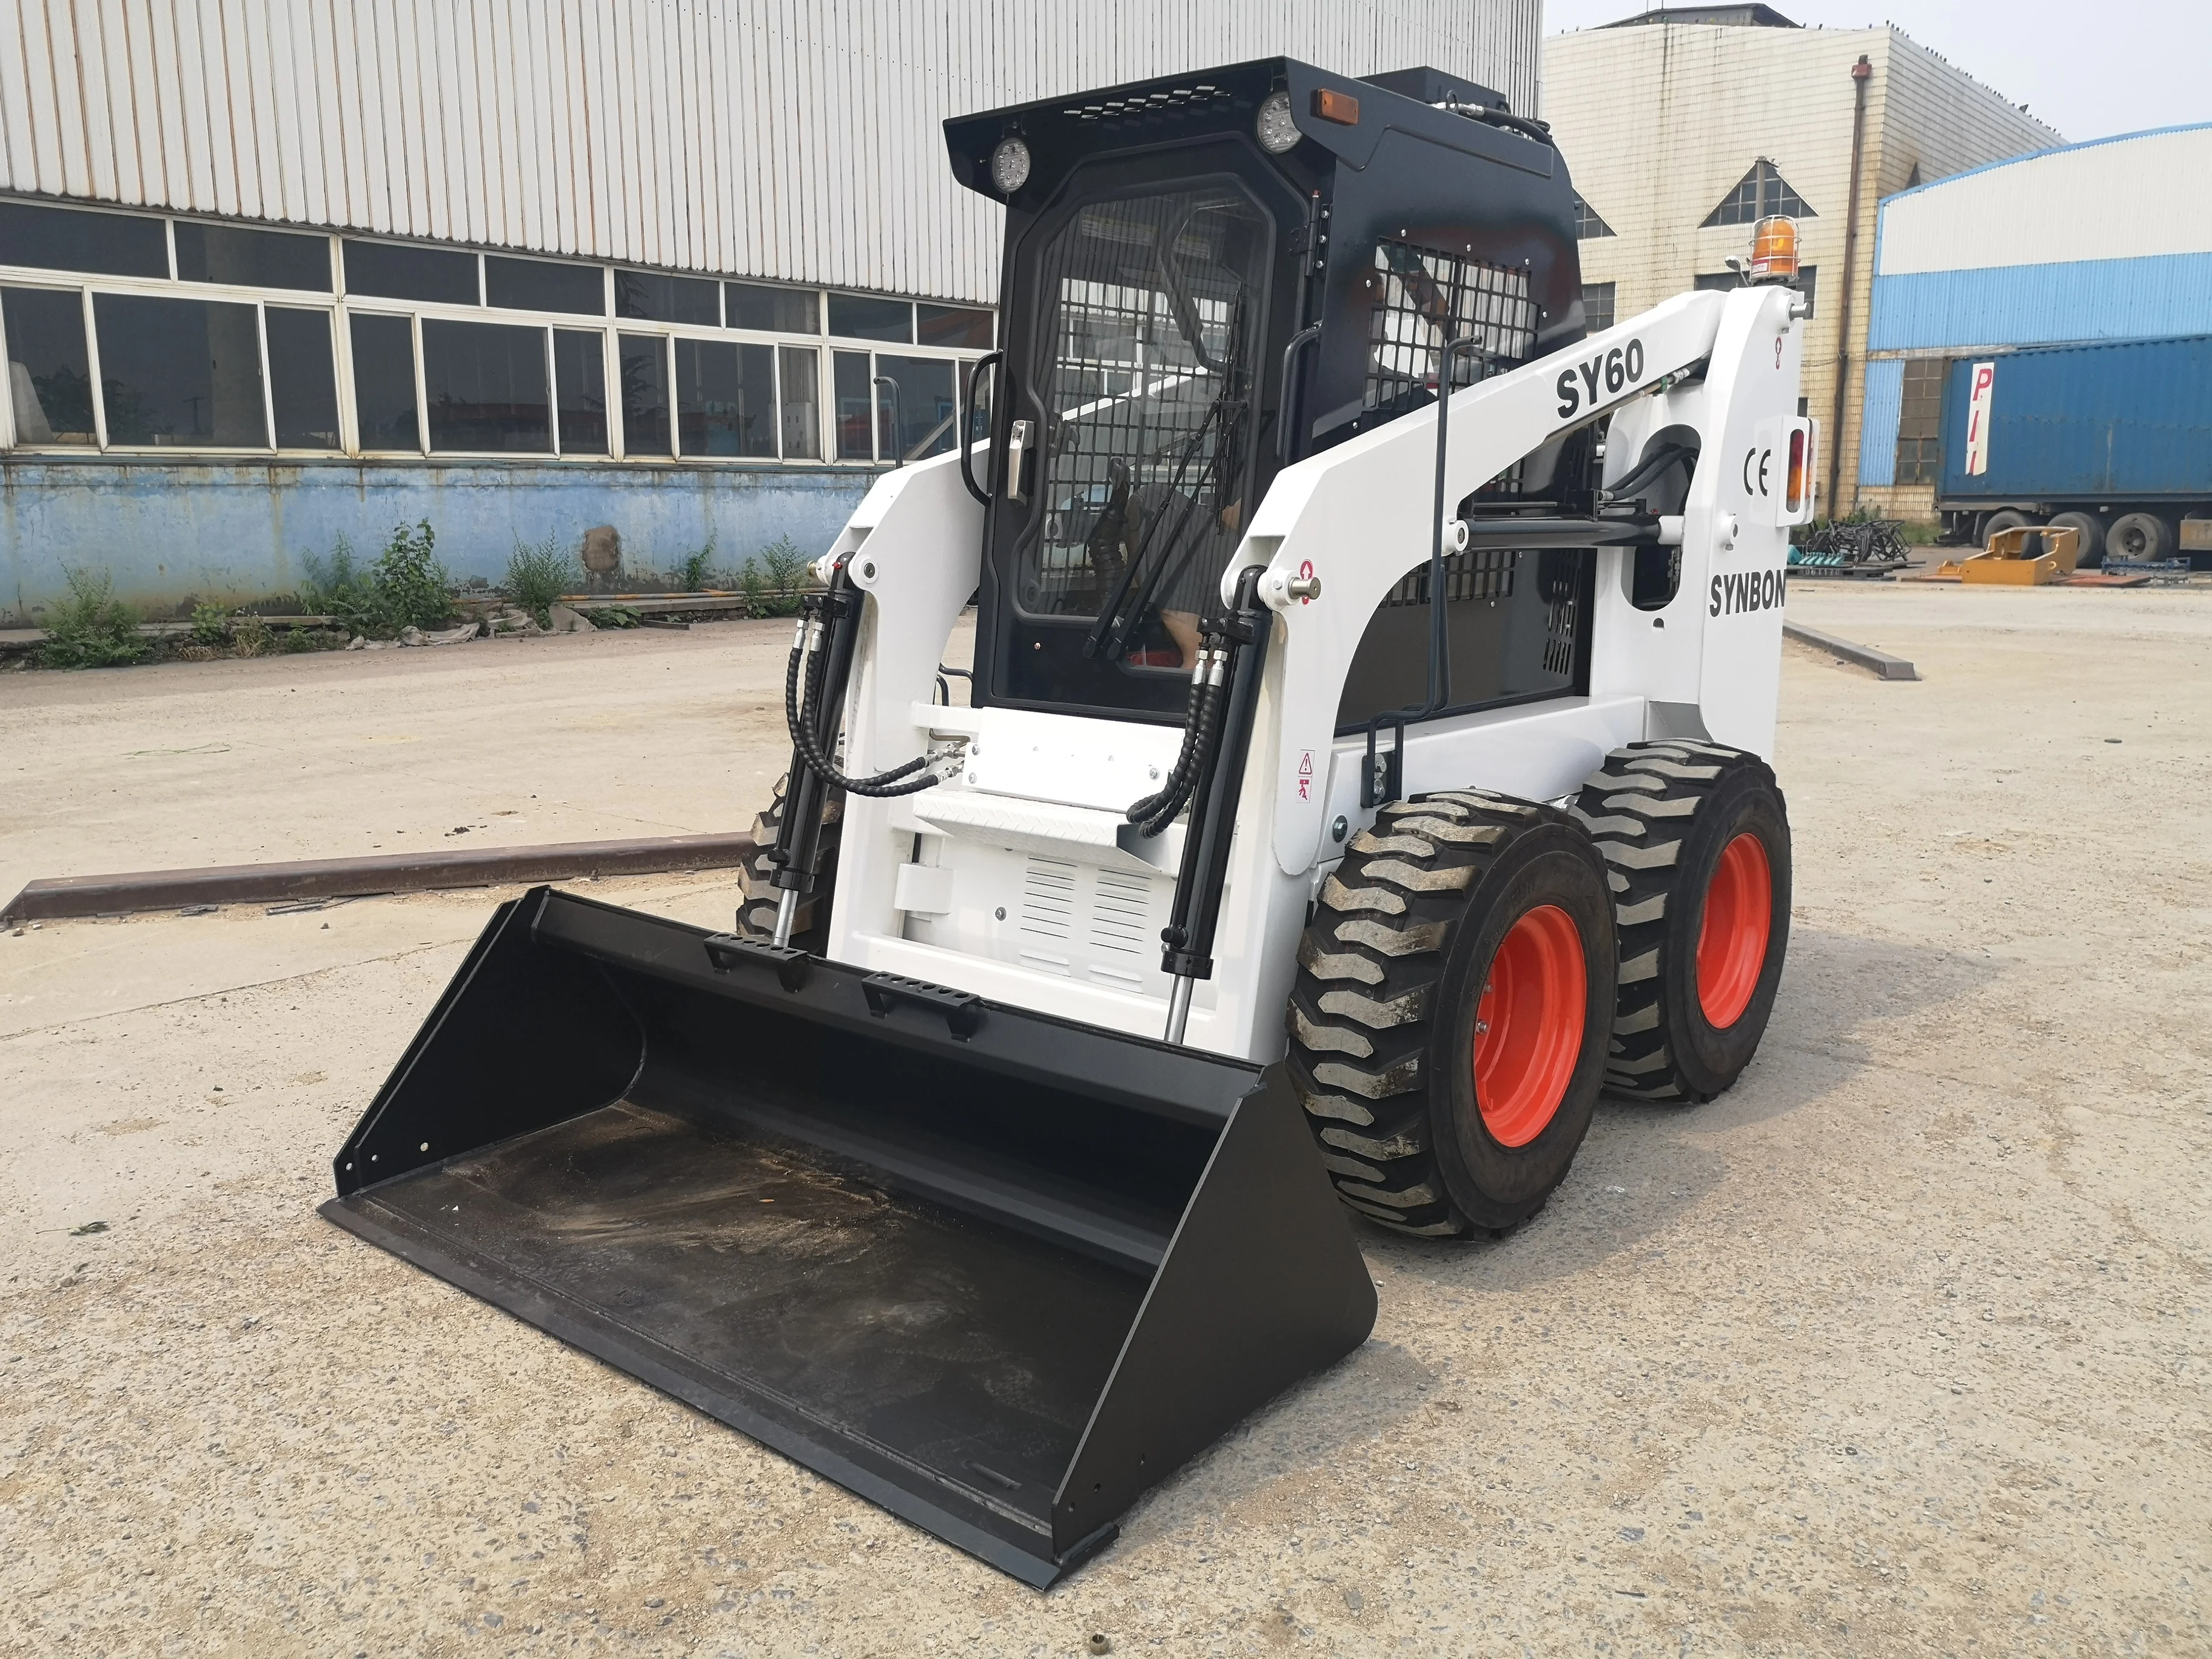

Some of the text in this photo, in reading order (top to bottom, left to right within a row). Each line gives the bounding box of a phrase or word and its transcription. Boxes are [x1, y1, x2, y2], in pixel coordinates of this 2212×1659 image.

[1557, 338, 1644, 418] SY60
[1743, 447, 1771, 497] CE
[1709, 569, 1786, 617] SYNBON
